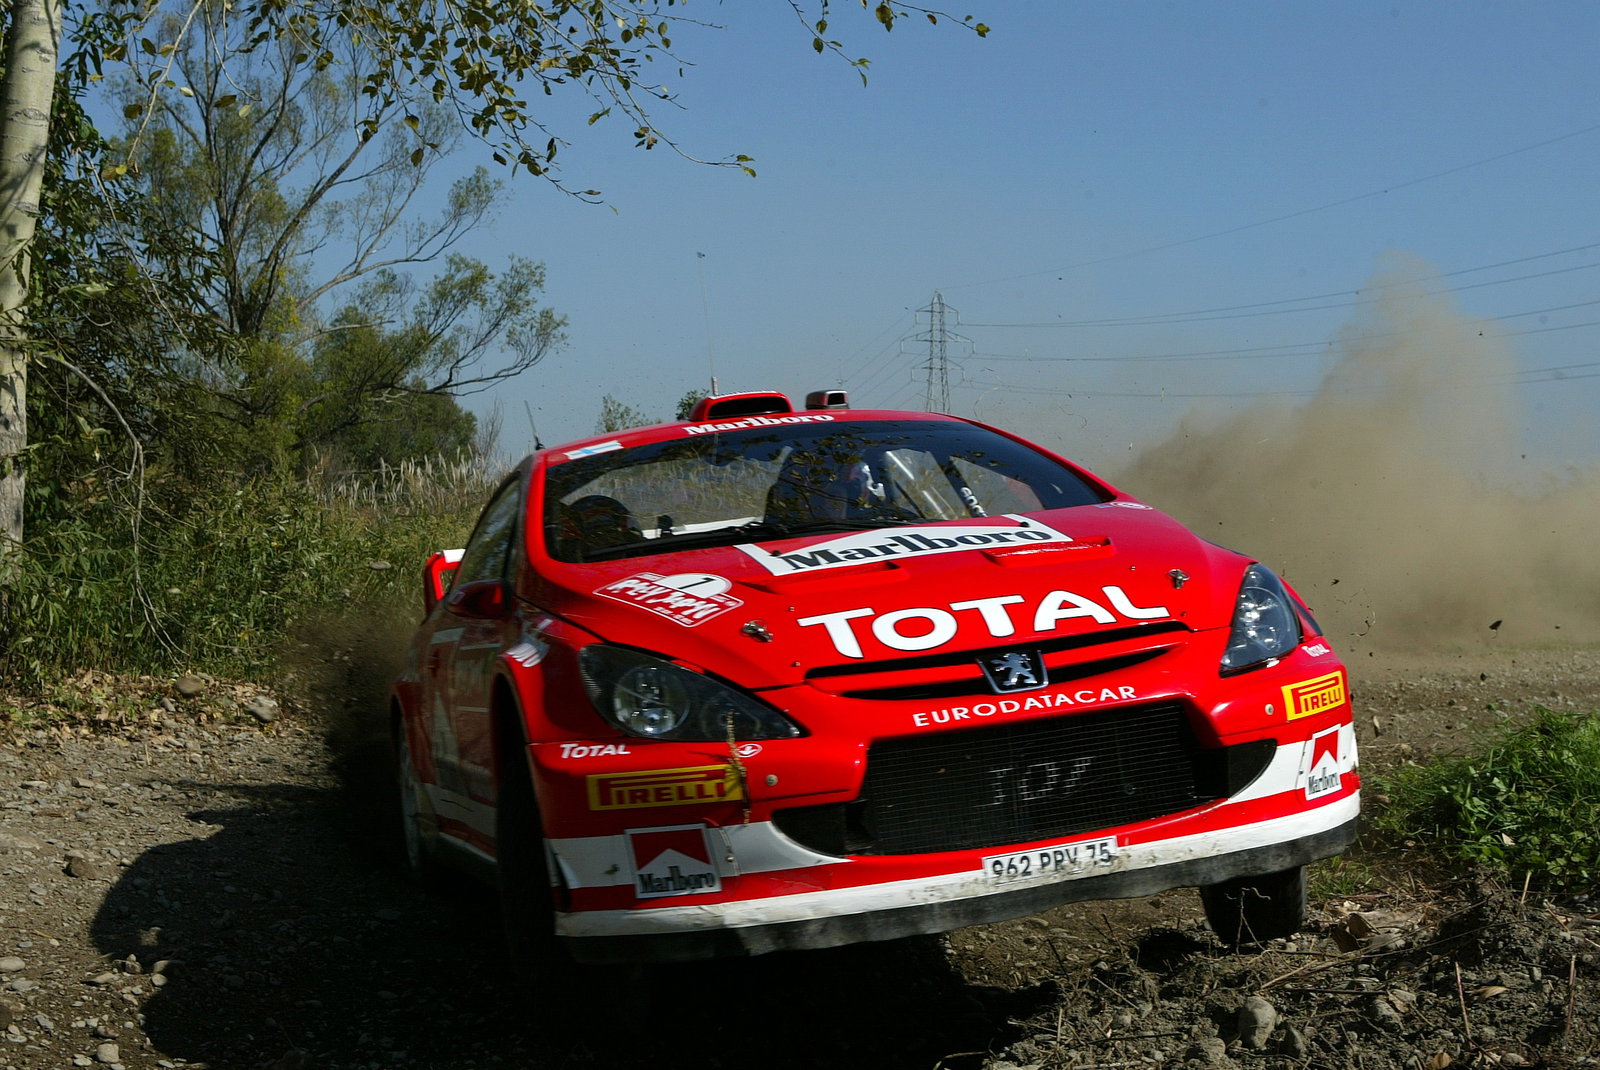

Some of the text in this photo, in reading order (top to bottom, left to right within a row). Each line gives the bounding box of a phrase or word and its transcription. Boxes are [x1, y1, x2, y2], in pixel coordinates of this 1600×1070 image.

[682, 414, 834, 435] Marlboro
[778, 529, 1053, 570] Marlboro
[677, 577, 716, 589] 1
[797, 585, 1170, 659] TOTAL
[912, 685, 1137, 727] EURODATACAR
[1290, 675, 1342, 714] PIRELLI
[560, 743, 631, 759] TOTAL
[596, 769, 726, 806] PIRELLI
[992, 855, 1031, 876] 962
[1086, 842, 1111, 863] 75
[638, 865, 716, 893] Marlboro
